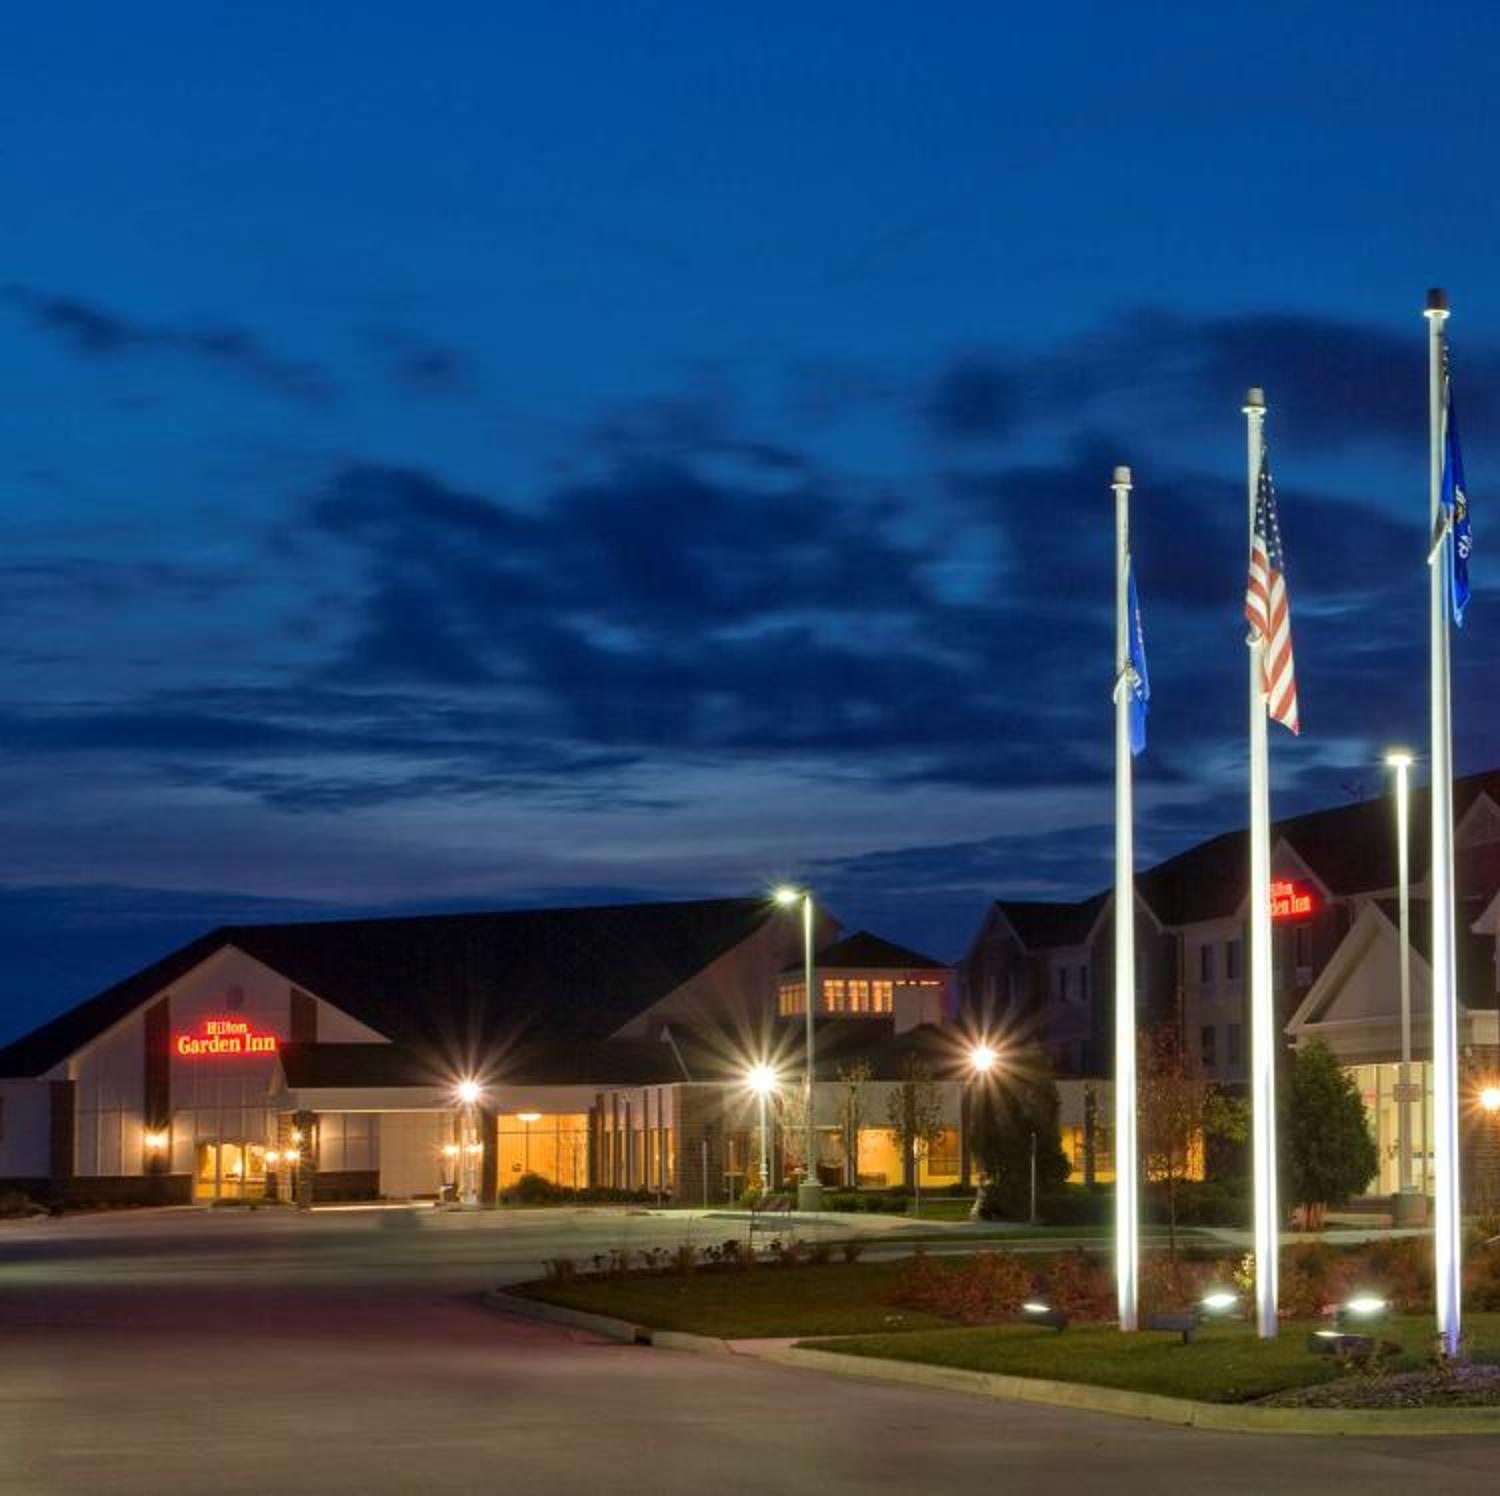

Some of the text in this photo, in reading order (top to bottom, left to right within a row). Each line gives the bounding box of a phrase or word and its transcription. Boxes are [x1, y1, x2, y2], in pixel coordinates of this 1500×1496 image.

[207, 1021, 248, 1035] Hilton
[178, 1033, 276, 1055] Garden Inn
